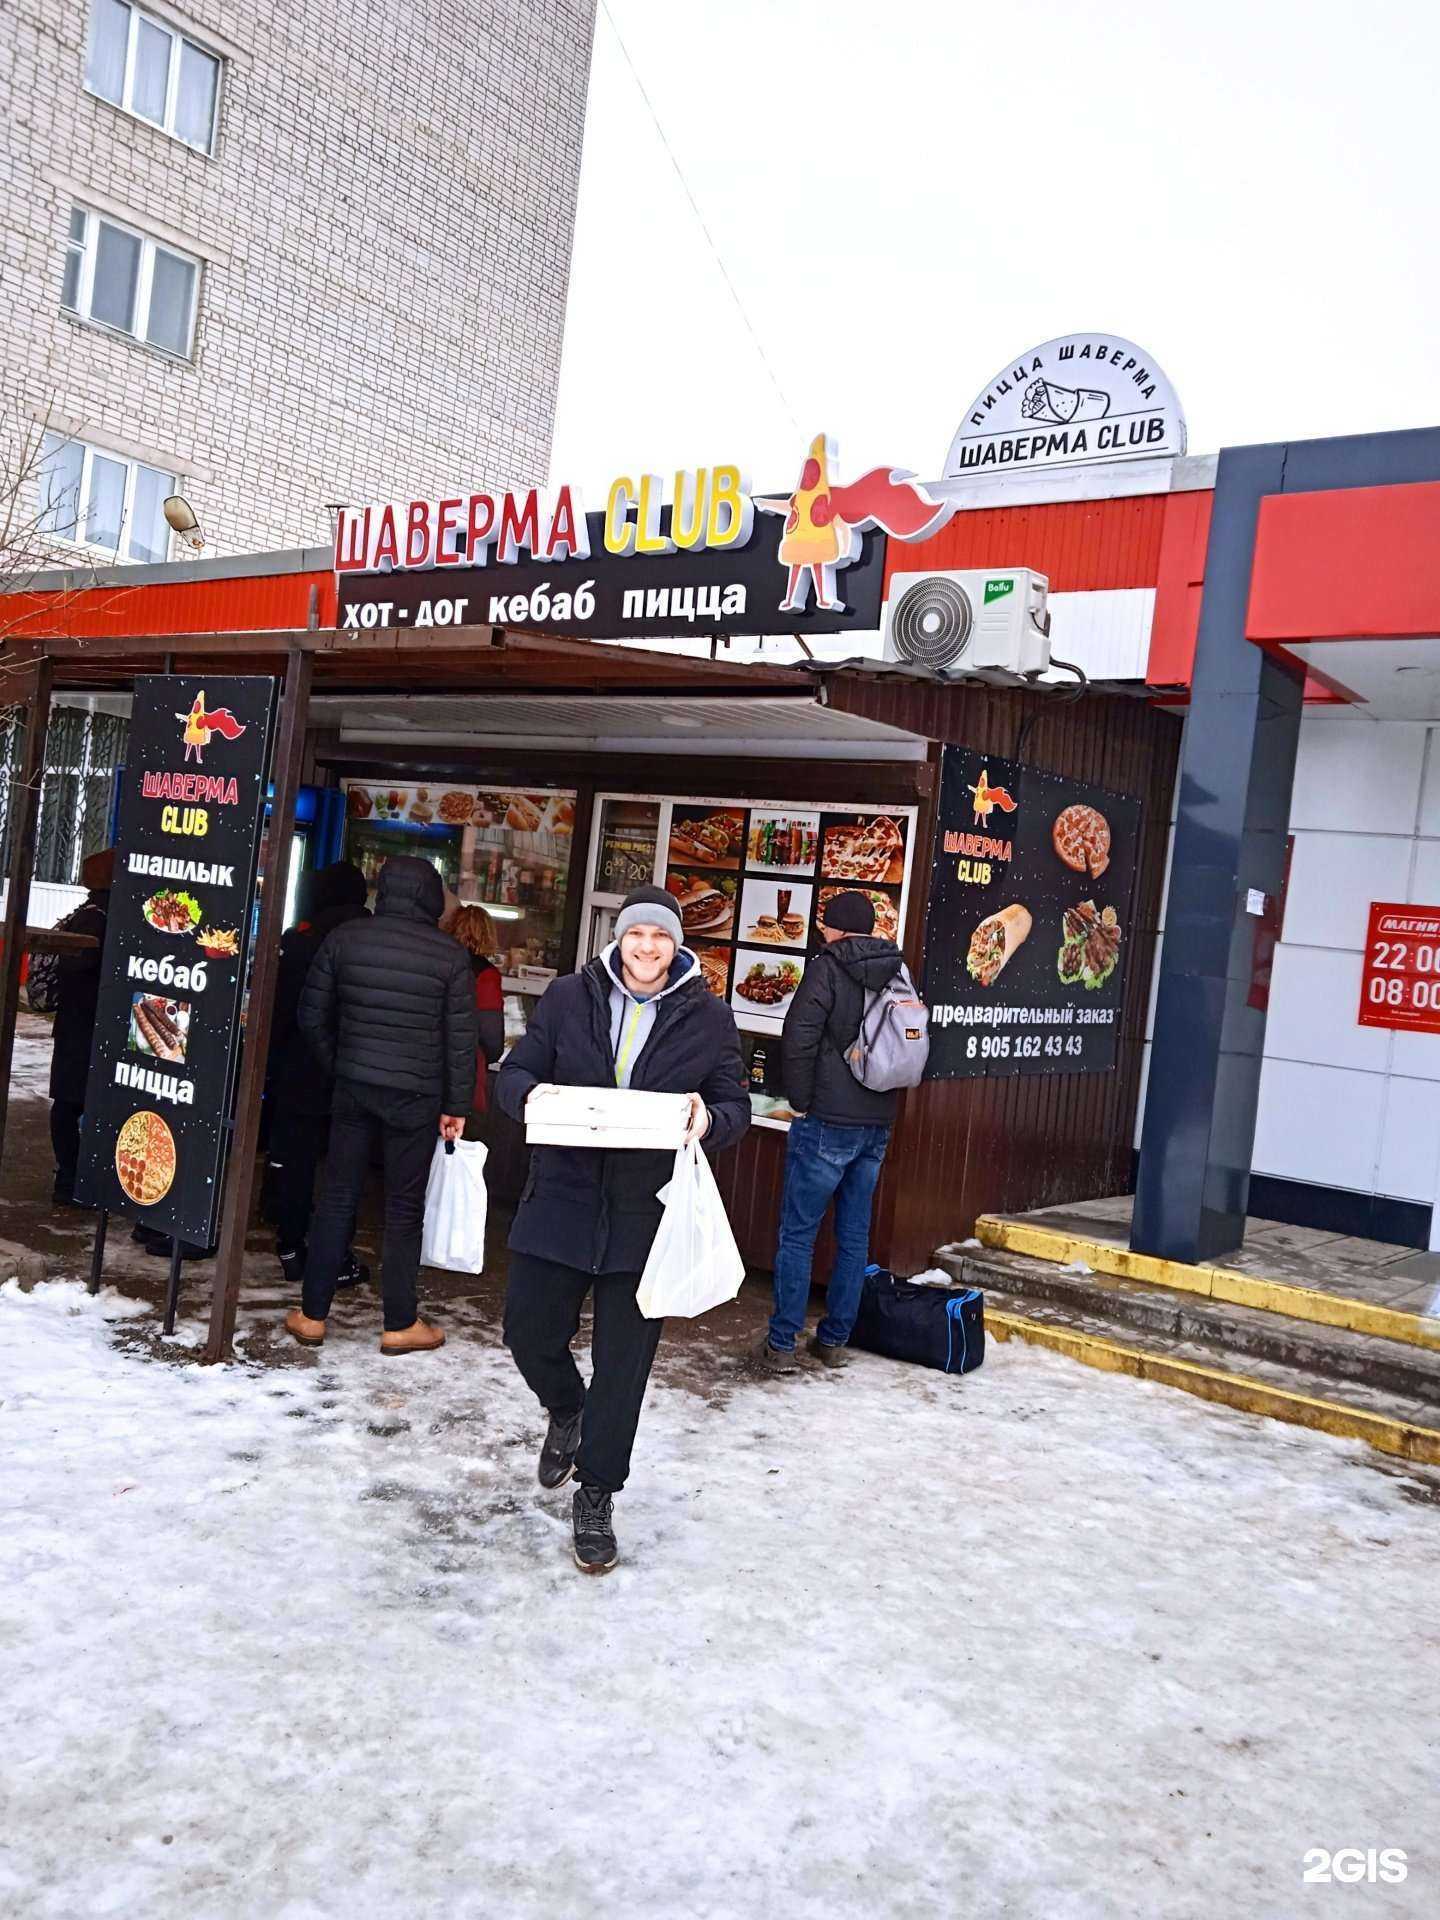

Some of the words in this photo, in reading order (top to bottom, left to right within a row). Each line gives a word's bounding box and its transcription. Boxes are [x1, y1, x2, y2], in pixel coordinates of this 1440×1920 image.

[971, 356, 1043, 426] ПИЦЦА
[1058, 344, 1157, 400] ШАВЕРМА
[959, 428, 1088, 469] ШАВЕРМА
[1096, 417, 1165, 450] CLUB
[334, 484, 584, 573] ШАВЕРМА
[604, 464, 747, 555] CLUB
[488, 580, 597, 624] кебаб
[622, 584, 748, 622] пицца
[988, 582, 1009, 592] Ballu
[142, 771, 239, 806] ШАВЕРМА
[161, 805, 208, 836] CLUB
[943, 829, 1012, 862] ШАВЕРМА
[127, 852, 235, 887] шашлык
[957, 860, 992, 885] CLUB
[1382, 919, 1440, 933] МАГНИ
[127, 954, 208, 992] кебаб
[931, 1001, 1075, 1028] предварительный
[1076, 1008, 1114, 1024] заказ
[966, 1036, 978, 1058] 8
[981, 1036, 1011, 1058] 905
[1013, 1035, 1042, 1058] 162
[1044, 1035, 1063, 1057] 43
[1065, 1034, 1083, 1056] 43
[114, 1061, 195, 1105] пицца
